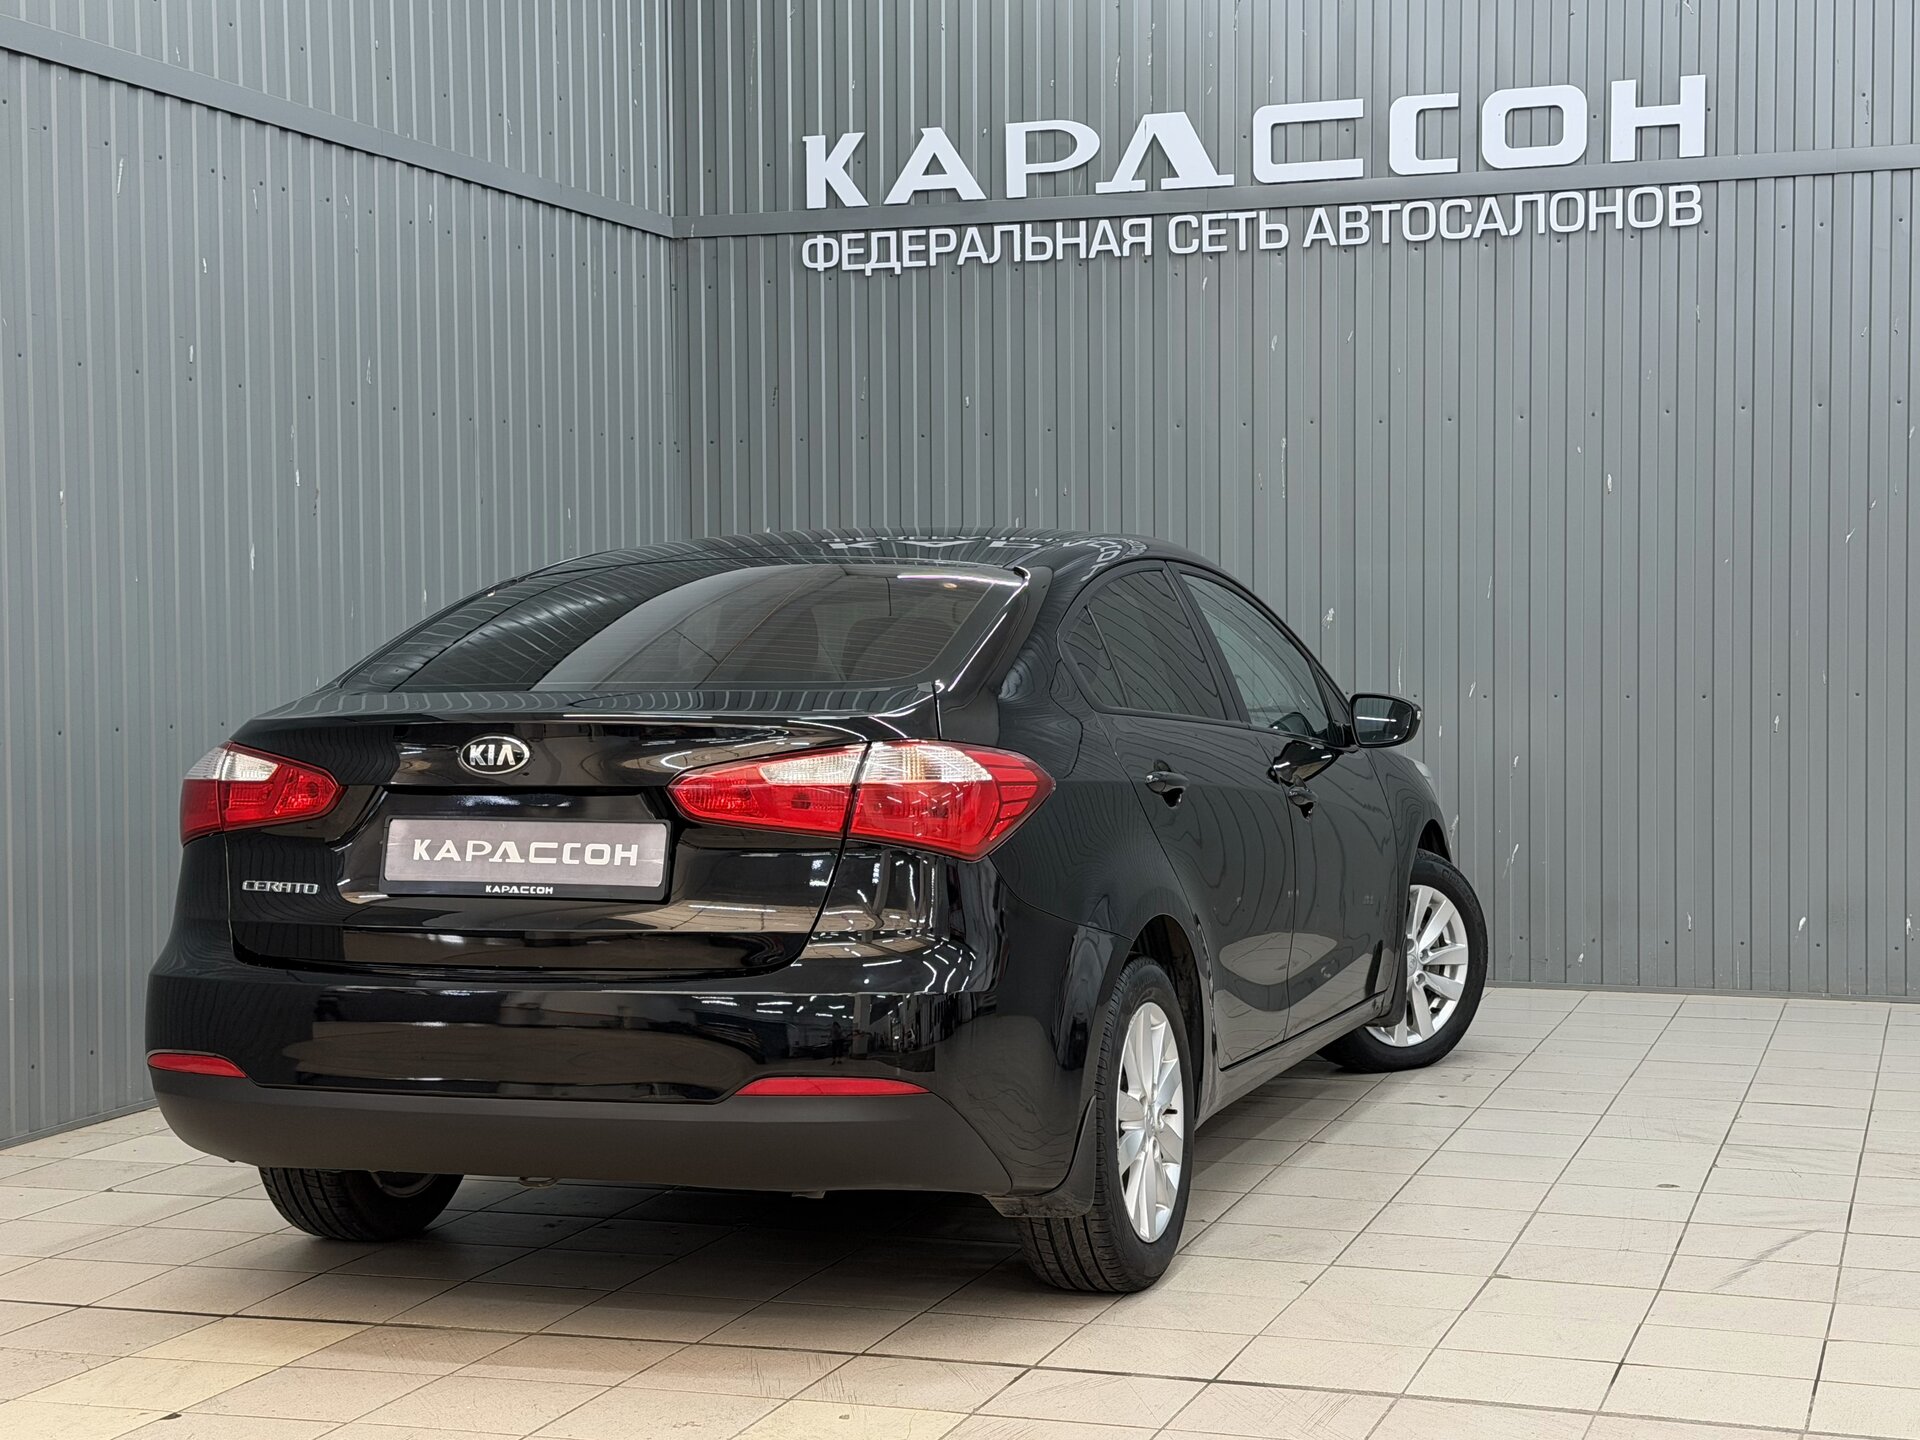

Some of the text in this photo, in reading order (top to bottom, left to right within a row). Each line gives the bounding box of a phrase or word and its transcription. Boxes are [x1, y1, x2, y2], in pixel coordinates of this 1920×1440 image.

[801, 183, 1703, 277] ФЕДЕРАЛЬНАЯ СЕТЬ АВТОСАЛОНОВ
[469, 744, 516, 766] KIA
[241, 879, 319, 895] CERATO
